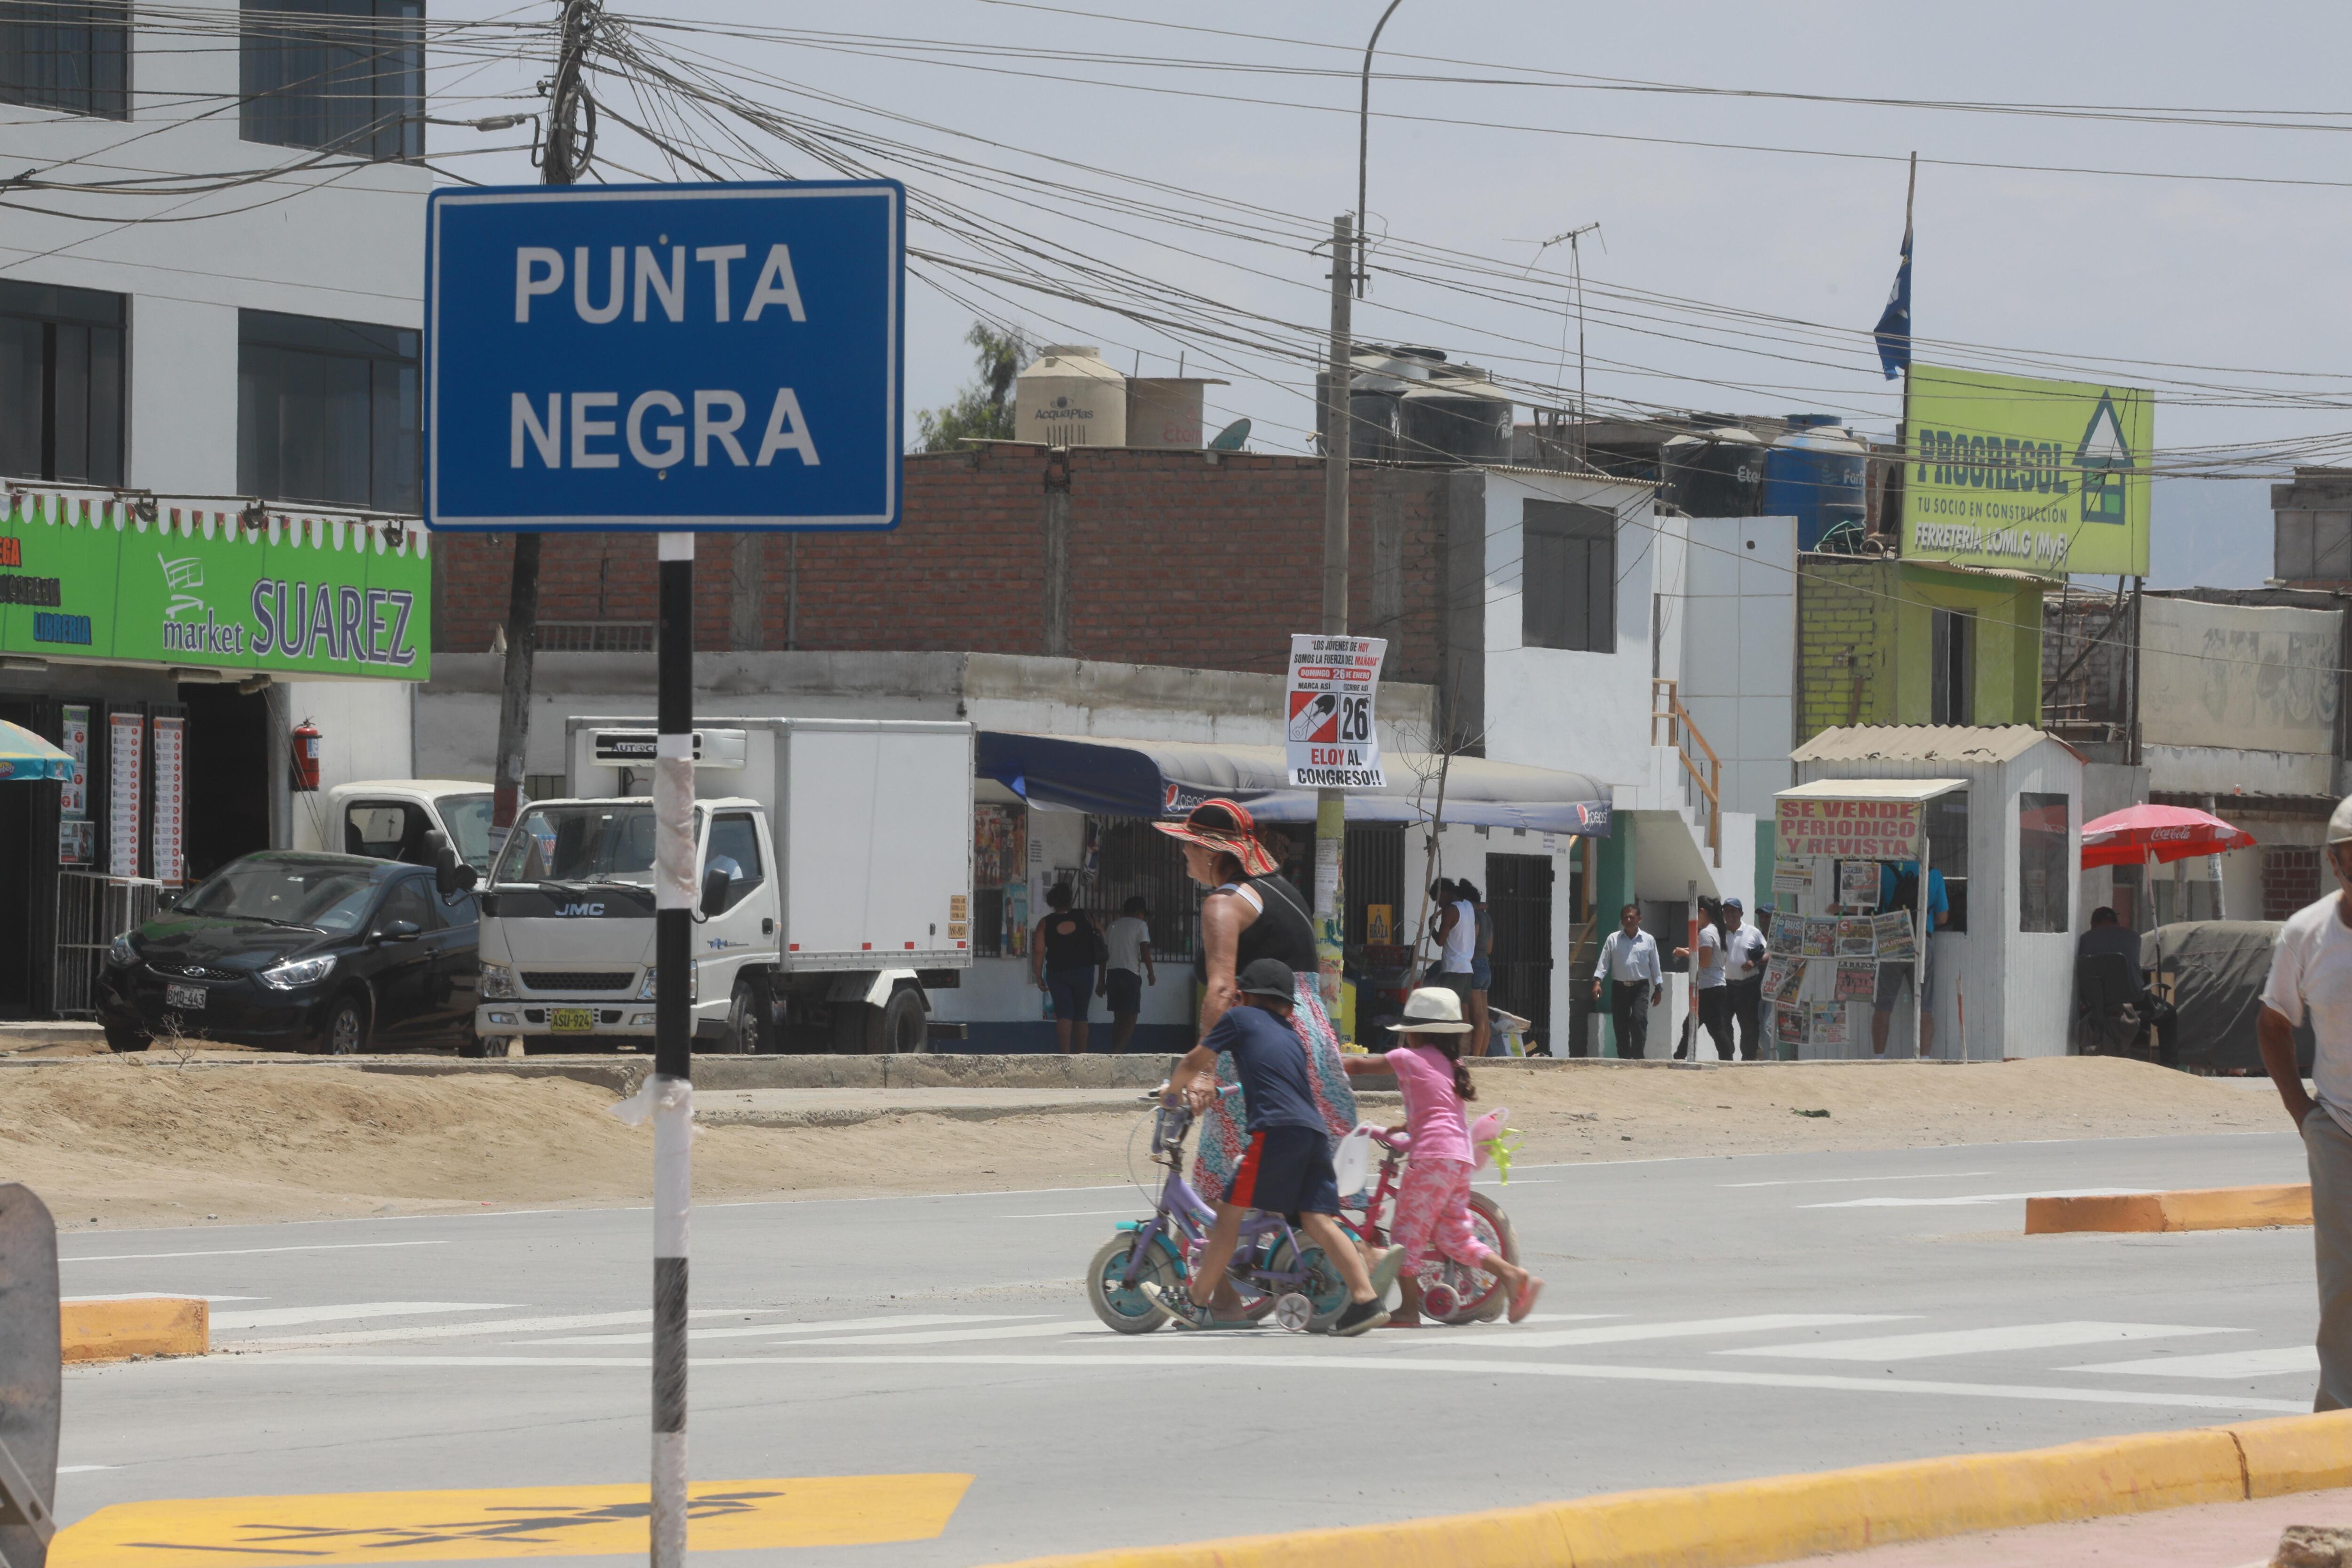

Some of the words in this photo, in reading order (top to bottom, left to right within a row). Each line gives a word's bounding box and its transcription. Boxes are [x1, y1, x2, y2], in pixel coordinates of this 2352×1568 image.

[515, 243, 807, 325] PUNTA
[1035, 409, 1094, 421] AcquaPlas
[510, 387, 821, 470] NEGRA
[1917, 429, 2069, 494] PROGRESOL
[1918, 497, 1930, 513] TU
[1933, 497, 1966, 517] SOCIO
[1970, 502, 1982, 518] EN
[1986, 502, 2067, 524] CONSTRUCCIÓN
[1914, 519, 1983, 553] FERRETERÍA
[1986, 527, 2032, 558] LOMI.G
[33, 611, 92, 645] LIBRERIA
[163, 607, 244, 655] market
[251, 577, 417, 667] SUAREZ
[1325, 639, 1348, 652] JÓVENES
[1350, 642, 1357, 652] DE
[1358, 643, 1369, 653] HOY
[1294, 653, 1315, 664] SOMOS
[1316, 654, 1323, 664] LA
[1324, 654, 1344, 665] FUERZA
[1345, 655, 1354, 665] DEL
[1301, 669, 1330, 678] DOMINGO
[1333, 669, 1345, 679] 26
[1352, 671, 1370, 679] ENERO
[1342, 697, 1367, 740] 26
[1311, 748, 1344, 765] ELOY
[1348, 749, 1362, 766] AL
[1297, 768, 1382, 786] CONGRESO!!
[1782, 802, 1815, 818] SE
[1822, 802, 1915, 819] VENDE
[1781, 820, 1916, 837] PERIODICO
[1786, 838, 1801, 853] Y
[1807, 838, 1909, 855] REVISTA
[555, 903, 605, 915] JMC
[553, 1014, 589, 1027] ASU-924
